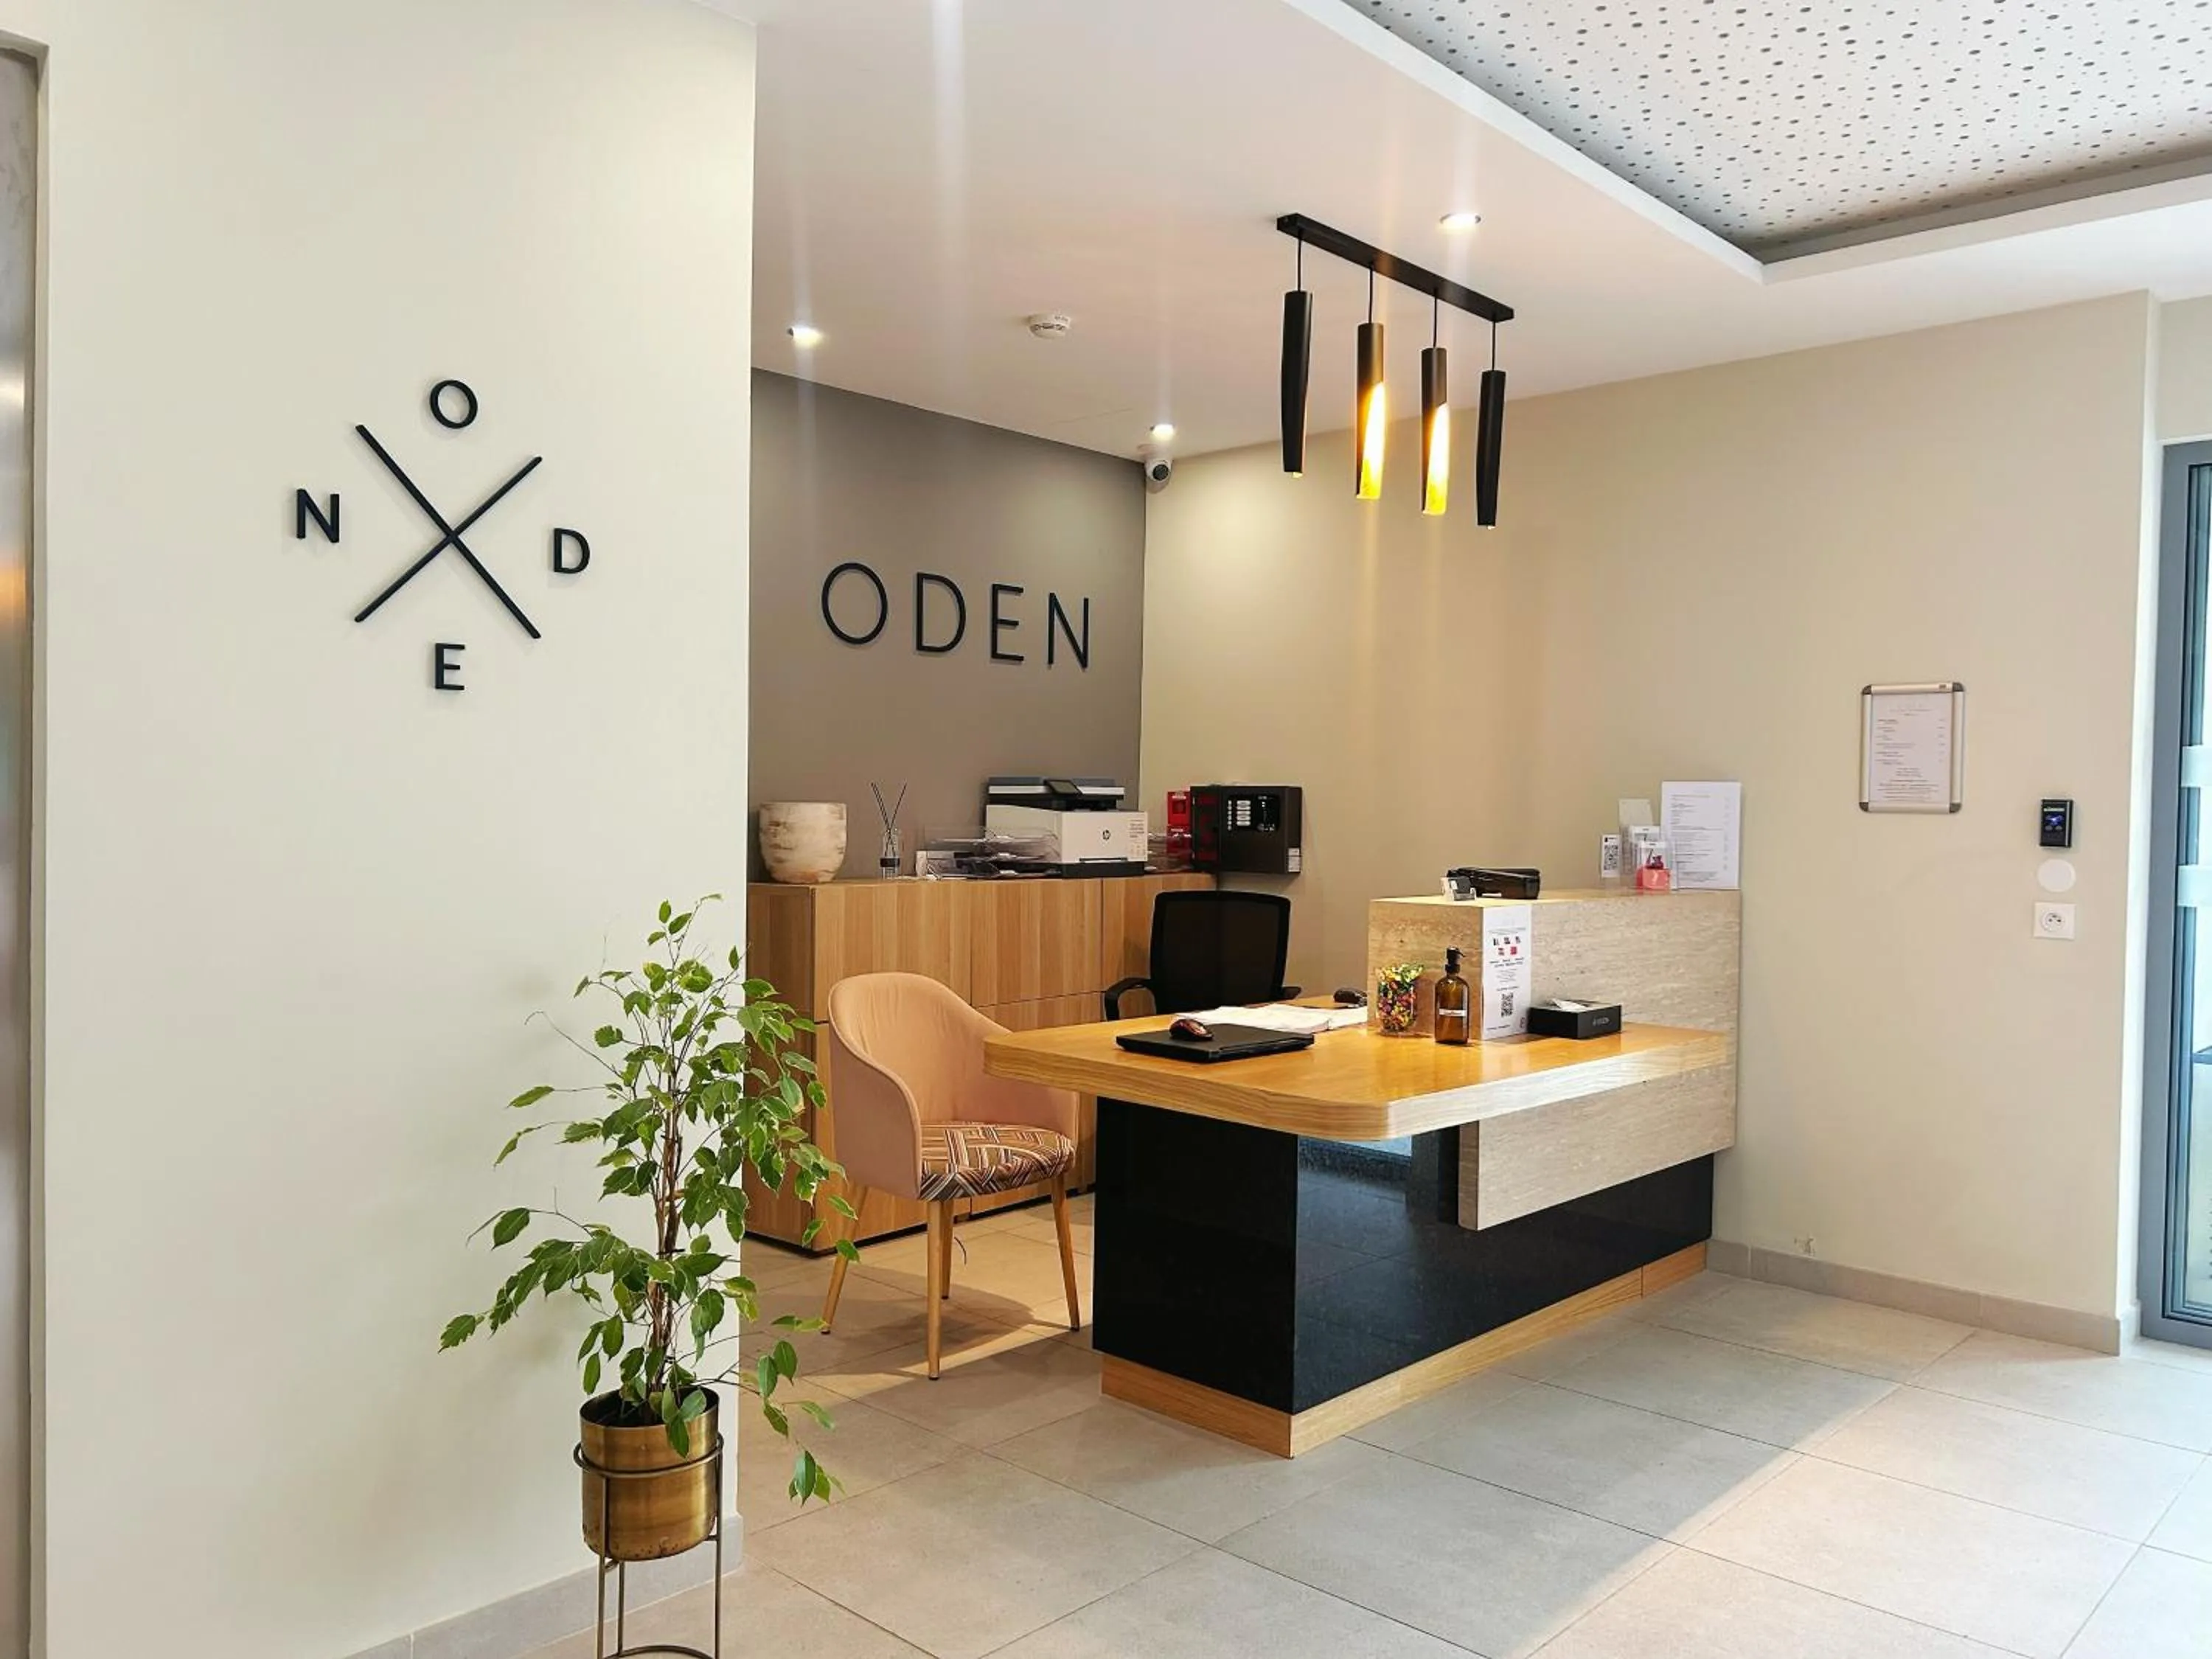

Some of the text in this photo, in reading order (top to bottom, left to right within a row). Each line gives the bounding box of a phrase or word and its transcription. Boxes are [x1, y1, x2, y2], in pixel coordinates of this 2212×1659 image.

[429, 379, 479, 429] O
[296, 489, 340, 543] N
[553, 527, 591, 574] D
[821, 562, 1090, 669] ODEN
[435, 642, 465, 691] E
